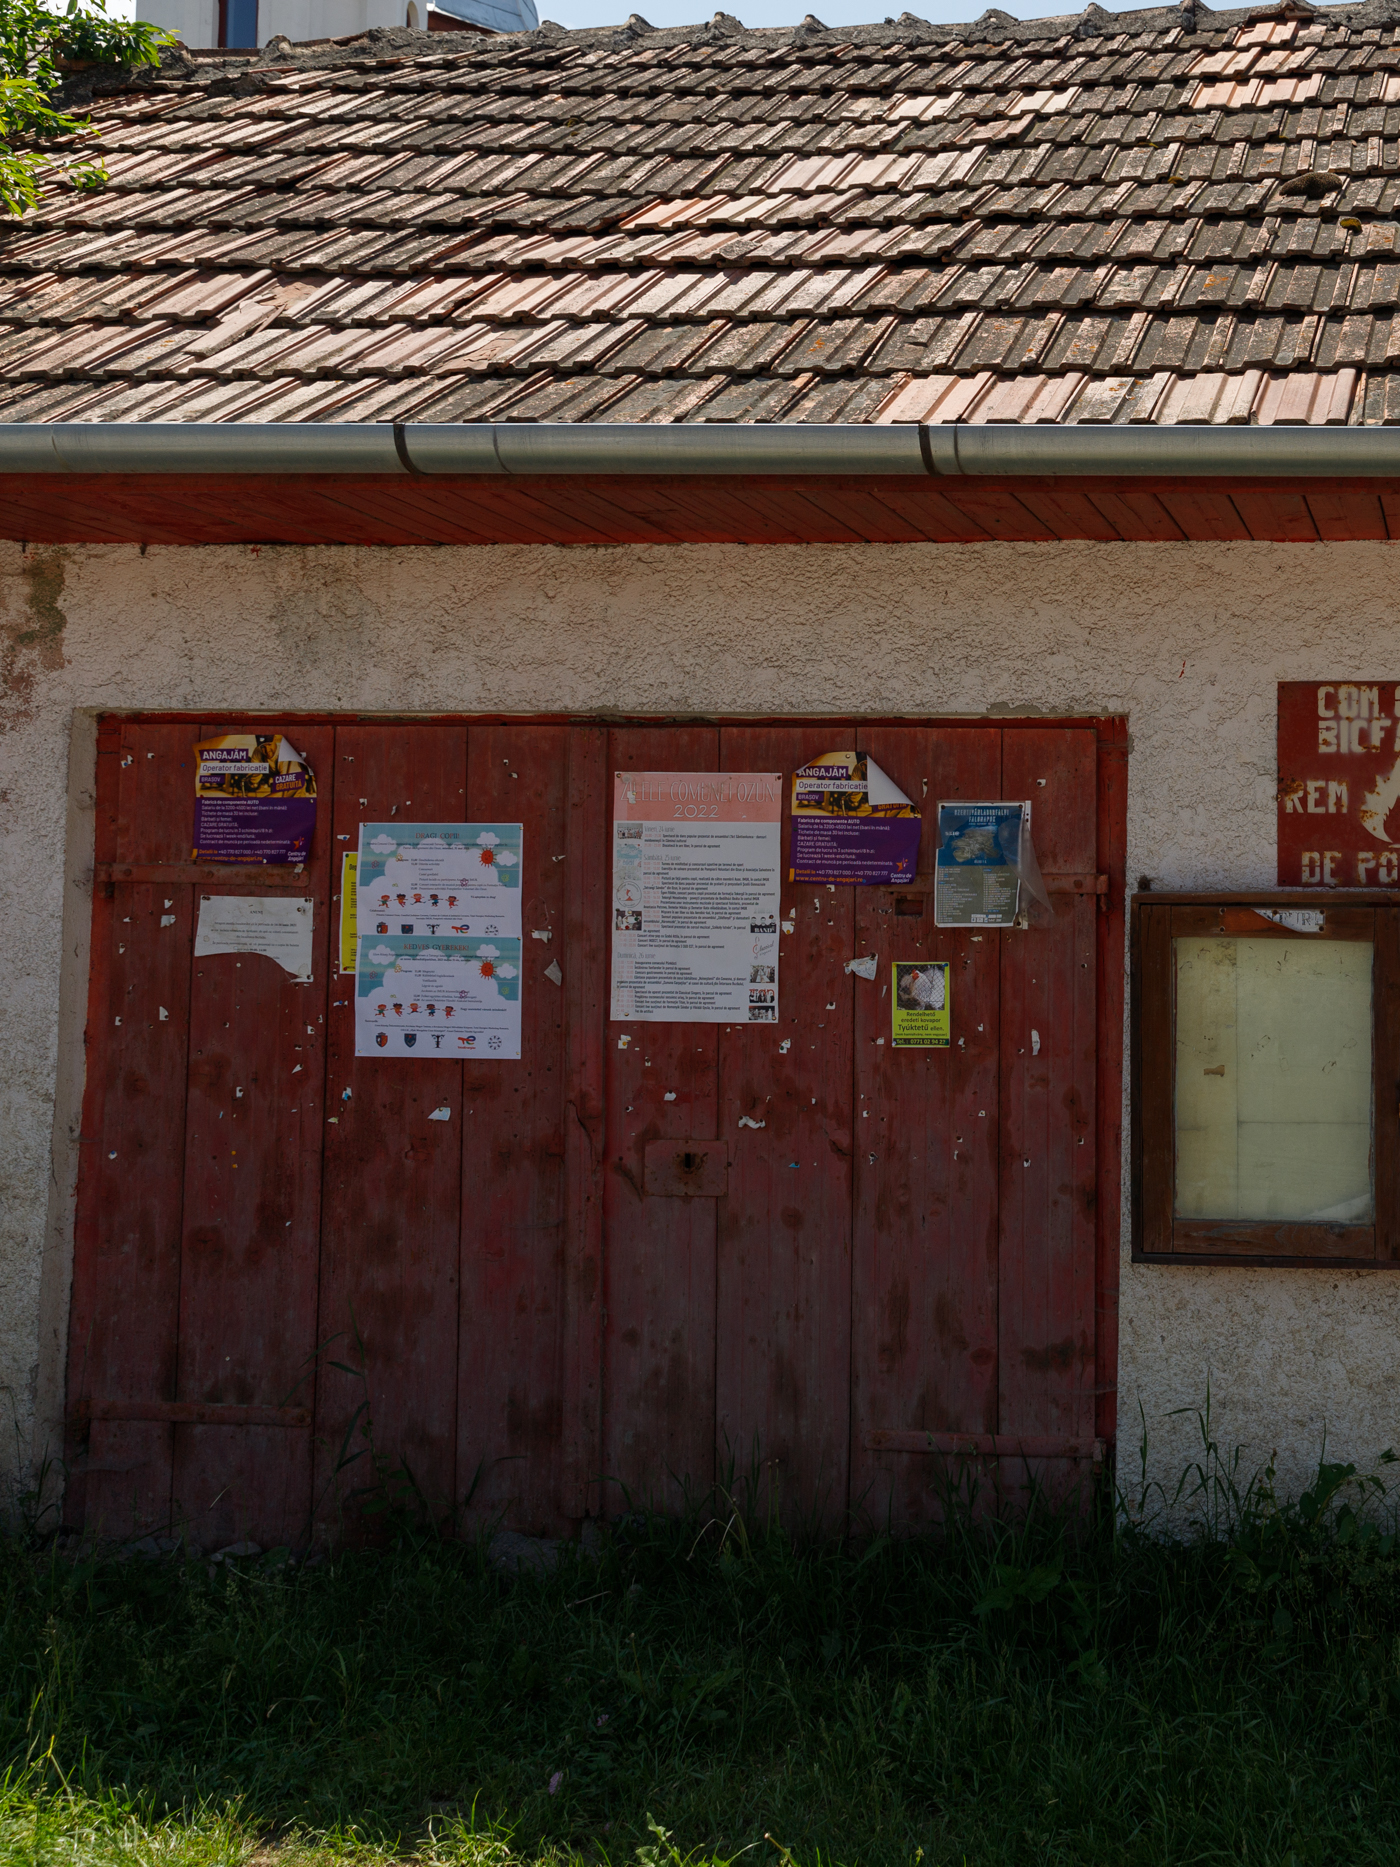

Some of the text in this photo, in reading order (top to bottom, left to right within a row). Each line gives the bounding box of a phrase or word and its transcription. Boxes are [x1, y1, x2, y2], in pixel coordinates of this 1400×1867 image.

[1317, 684, 1385, 718] COM.
[203, 750, 247, 760] ANGAJĂM
[202, 764, 232, 772] Operator
[798, 766, 846, 777] ANGAJĂM
[275, 774, 297, 784] CAZARE
[798, 781, 832, 790] Operator
[670, 782, 732, 802] COMUNEI
[737, 782, 776, 802] OZUN
[1285, 780, 1348, 813] REM
[673, 805, 720, 818] 2022
[1301, 851, 1342, 884] DE
[898, 1024, 928, 1032] Tyúktetű
